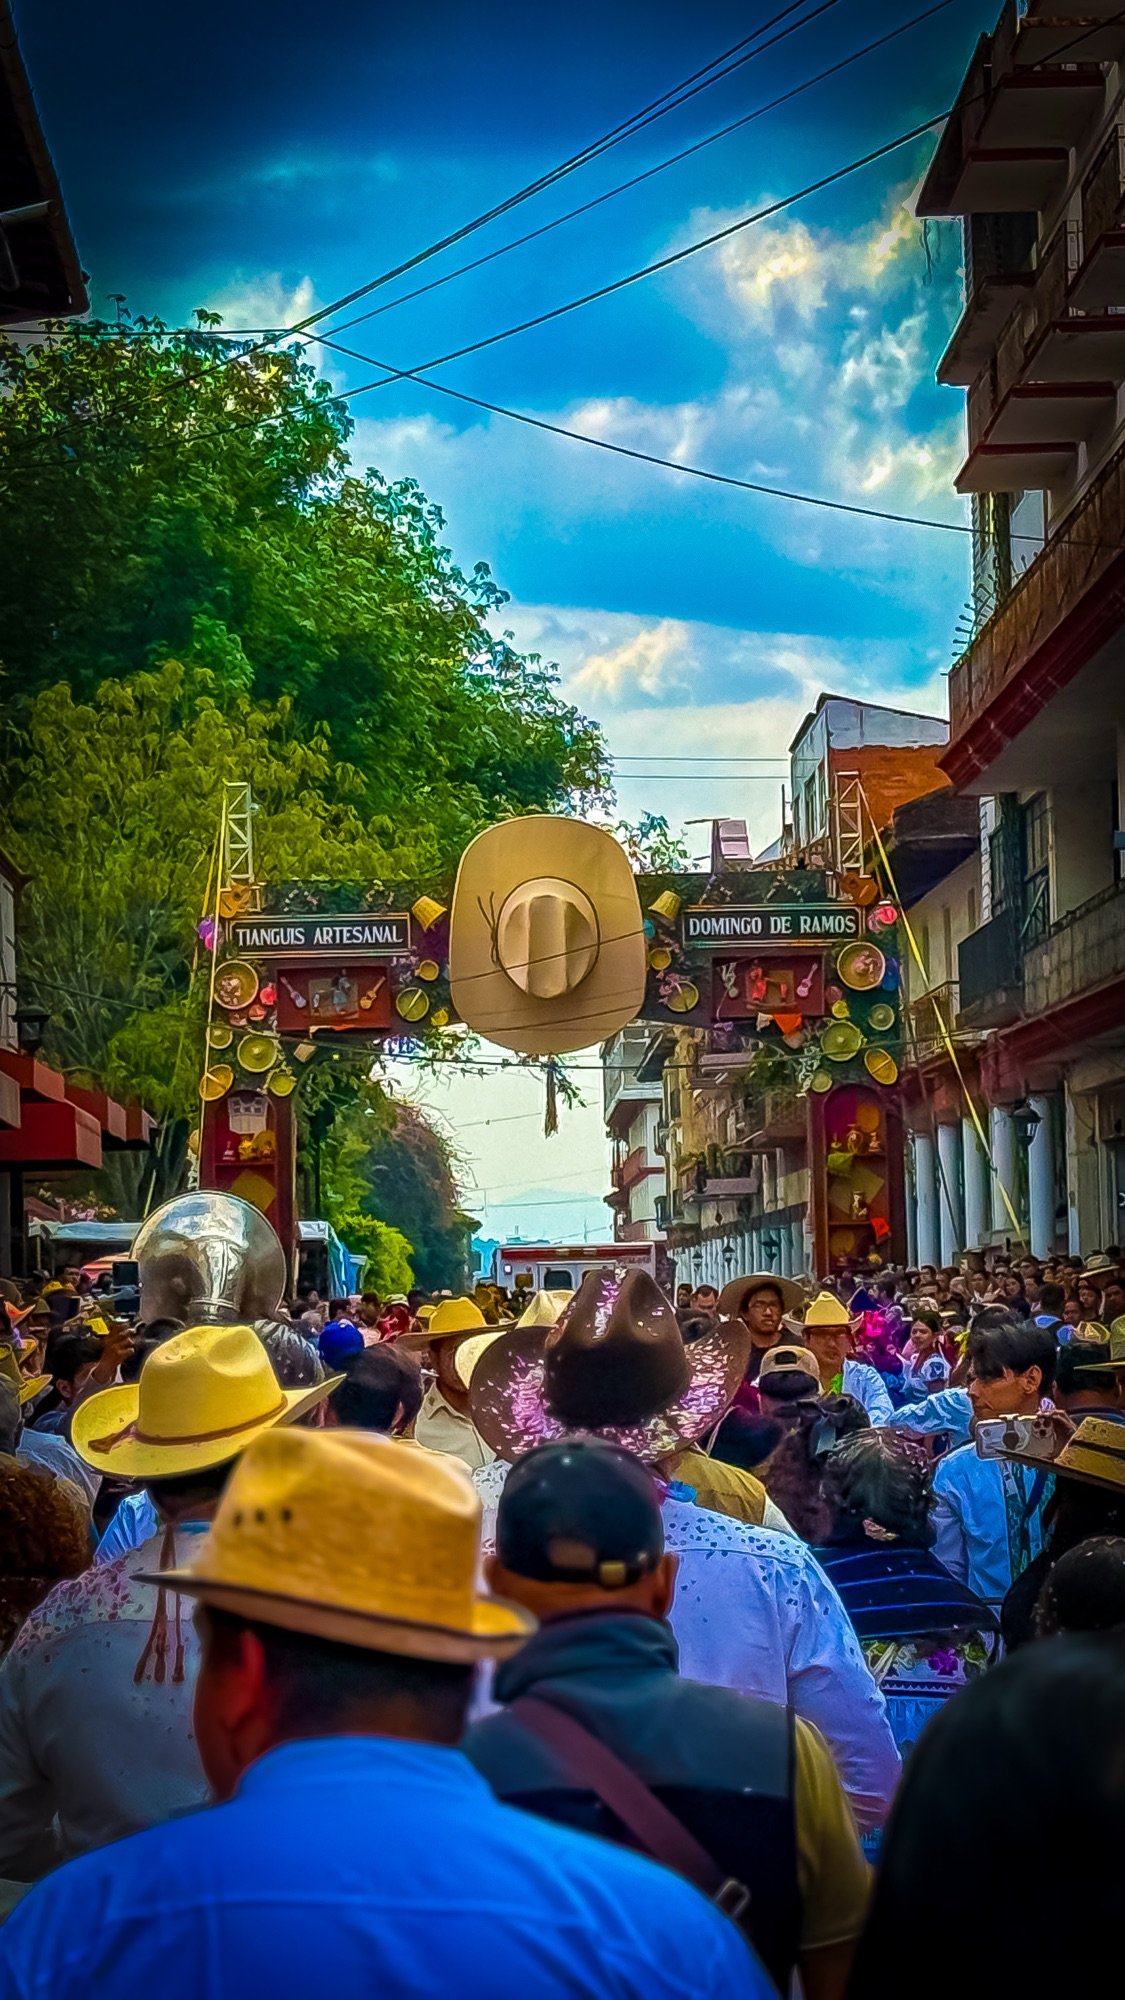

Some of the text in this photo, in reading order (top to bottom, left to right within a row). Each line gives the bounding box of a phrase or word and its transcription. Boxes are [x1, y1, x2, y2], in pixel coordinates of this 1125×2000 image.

[236, 925, 404, 946] TIANGUIS ARTESANAL
[689, 915, 857, 936] DOMINGO DE RAMOS
